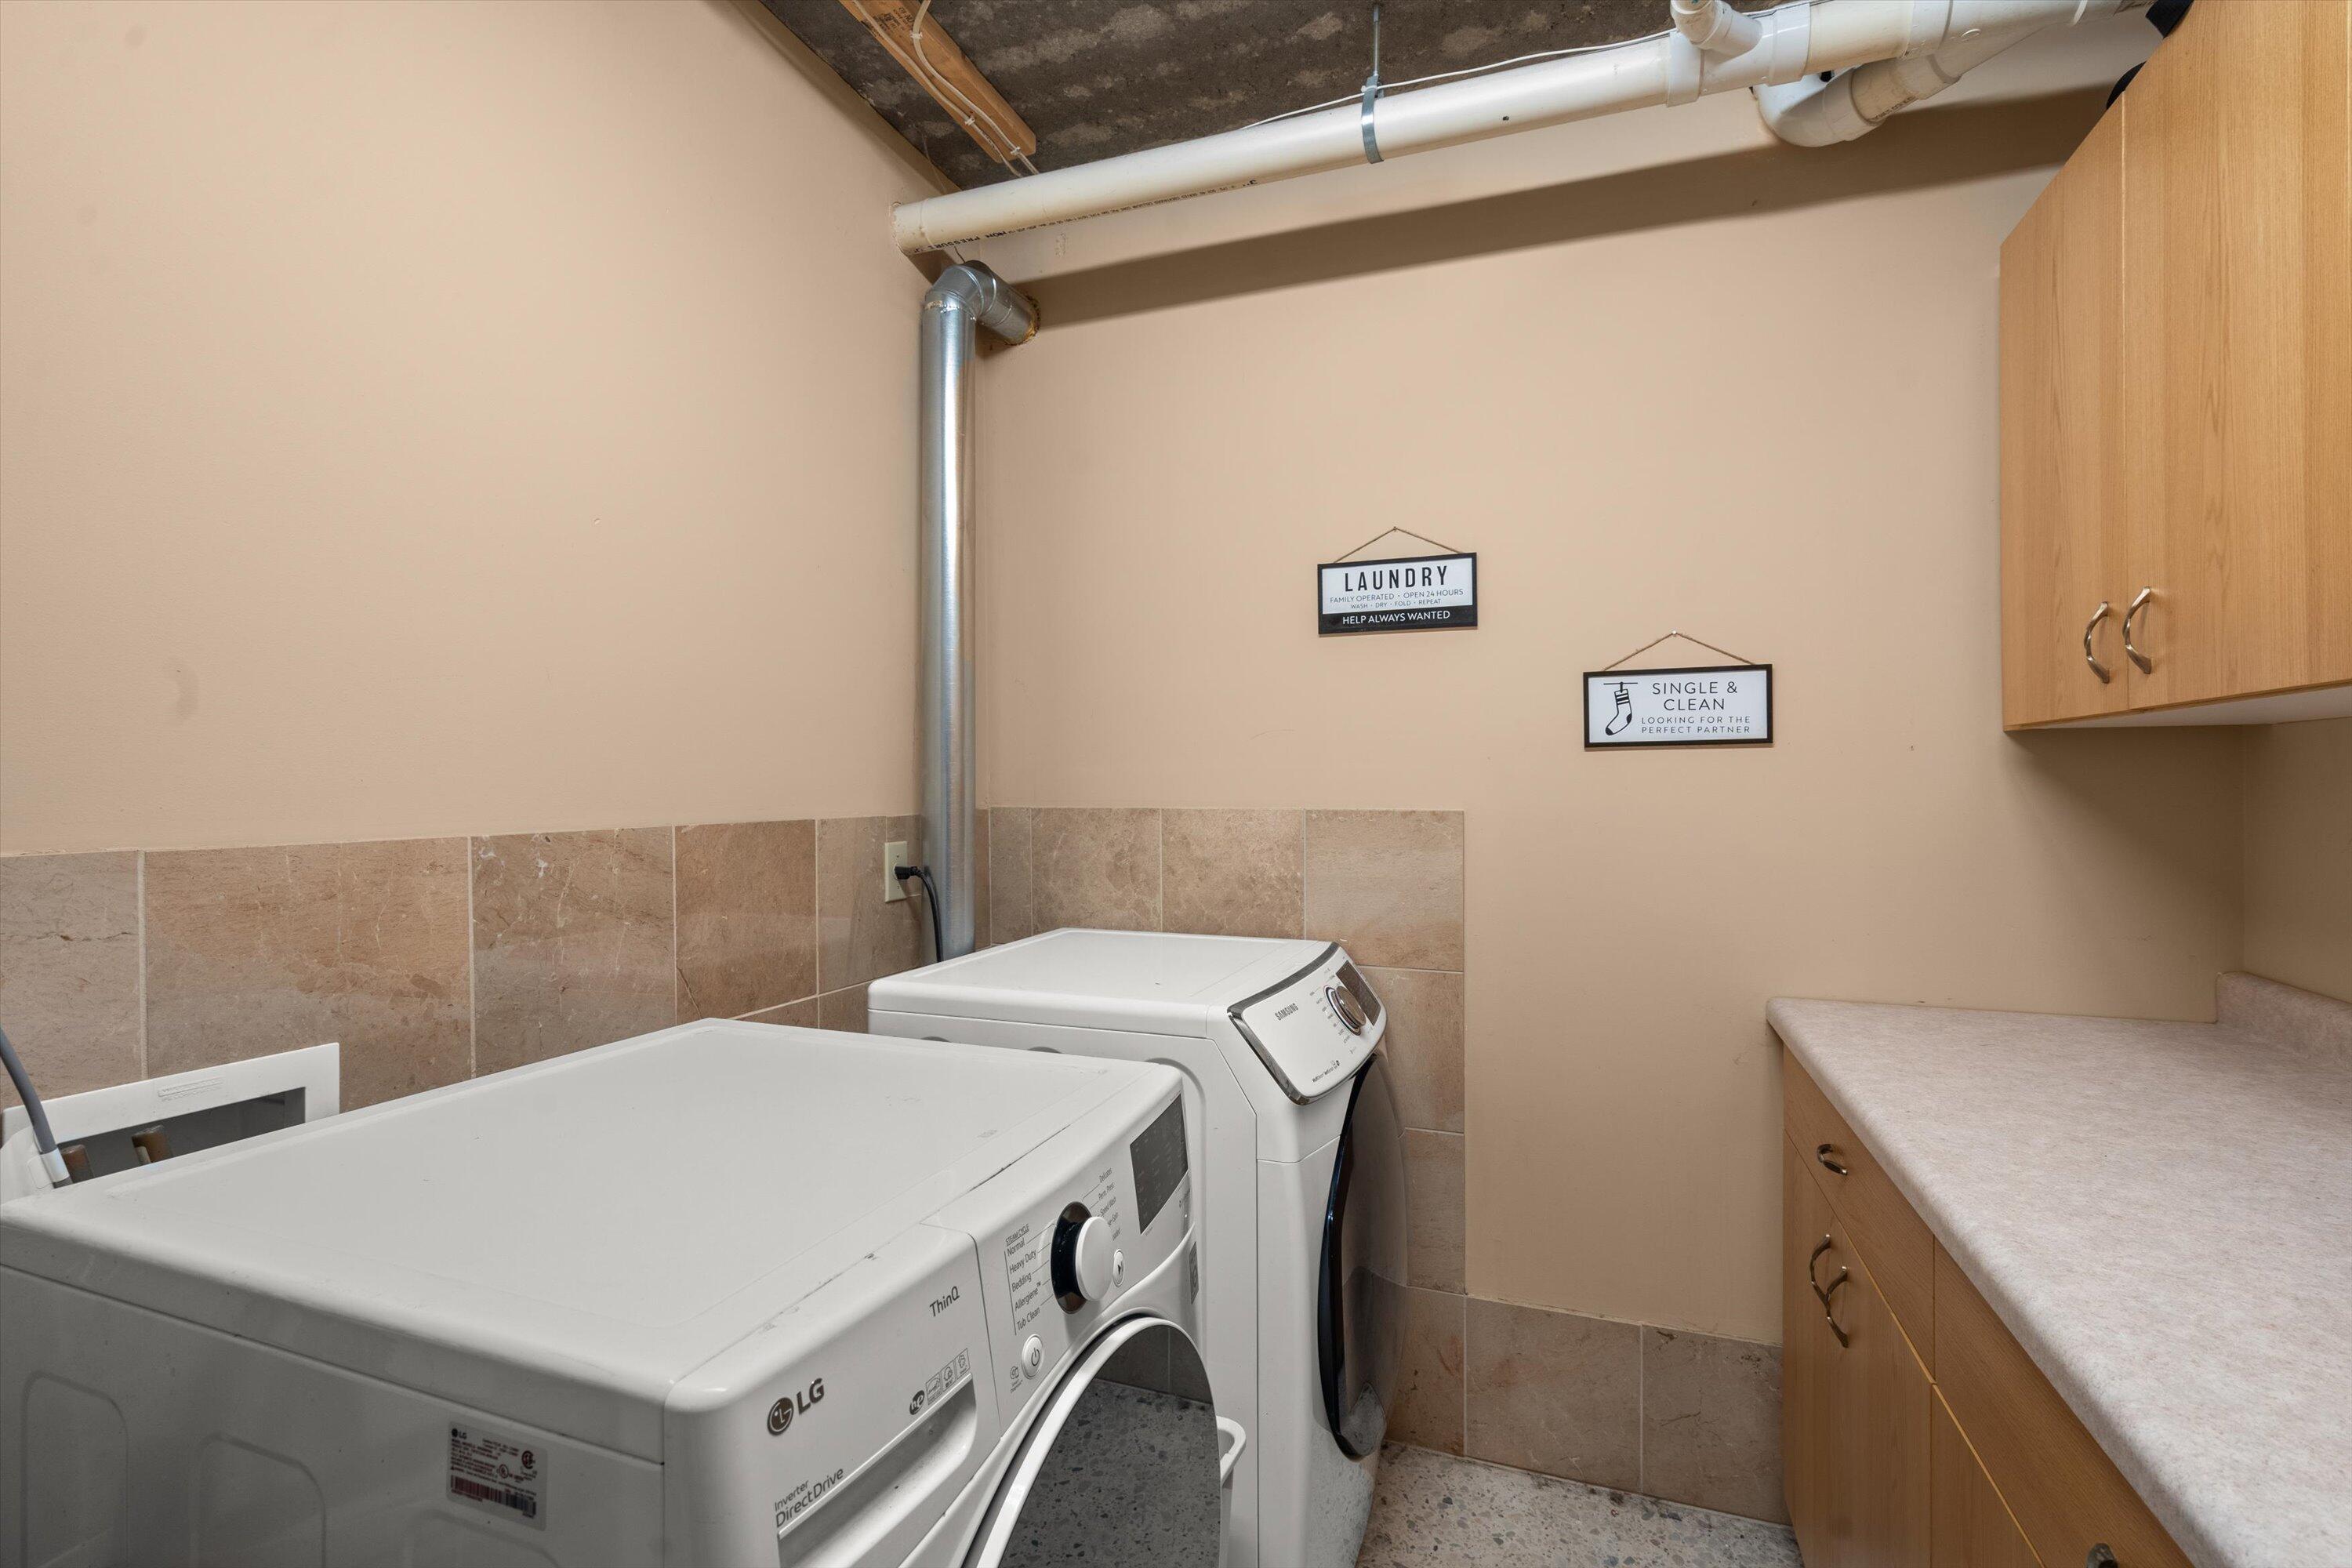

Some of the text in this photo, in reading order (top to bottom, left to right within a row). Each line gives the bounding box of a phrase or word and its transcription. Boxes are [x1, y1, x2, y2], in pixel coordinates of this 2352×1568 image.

[1345, 565, 1447, 592] LAUNDRY
[1356, 593, 1395, 602] OPERATED
[1342, 610, 1450, 625] HELP ALWAYS WANTED
[1652, 681, 1737, 695] SINGLE &
[1664, 699, 1725, 711] CLEAN
[1641, 716, 1695, 724] LOOKING
[1729, 715, 1751, 724] THE
[1697, 725, 1751, 734] PARTNER
[1275, 1003, 1298, 1021] SAMSUNG
[1006, 1223, 1029, 1245] STEAM CYCLE
[1007, 1238, 1025, 1257] Normal
[1009, 1250, 1036, 1274] Heavy Duty
[1011, 1272, 1032, 1292] Bedding
[929, 1286, 960, 1318] ThinQ
[1017, 1307, 1040, 1330] Tub Clean
[796, 1377, 825, 1415] LG
[774, 1479, 809, 1512] Inverter
